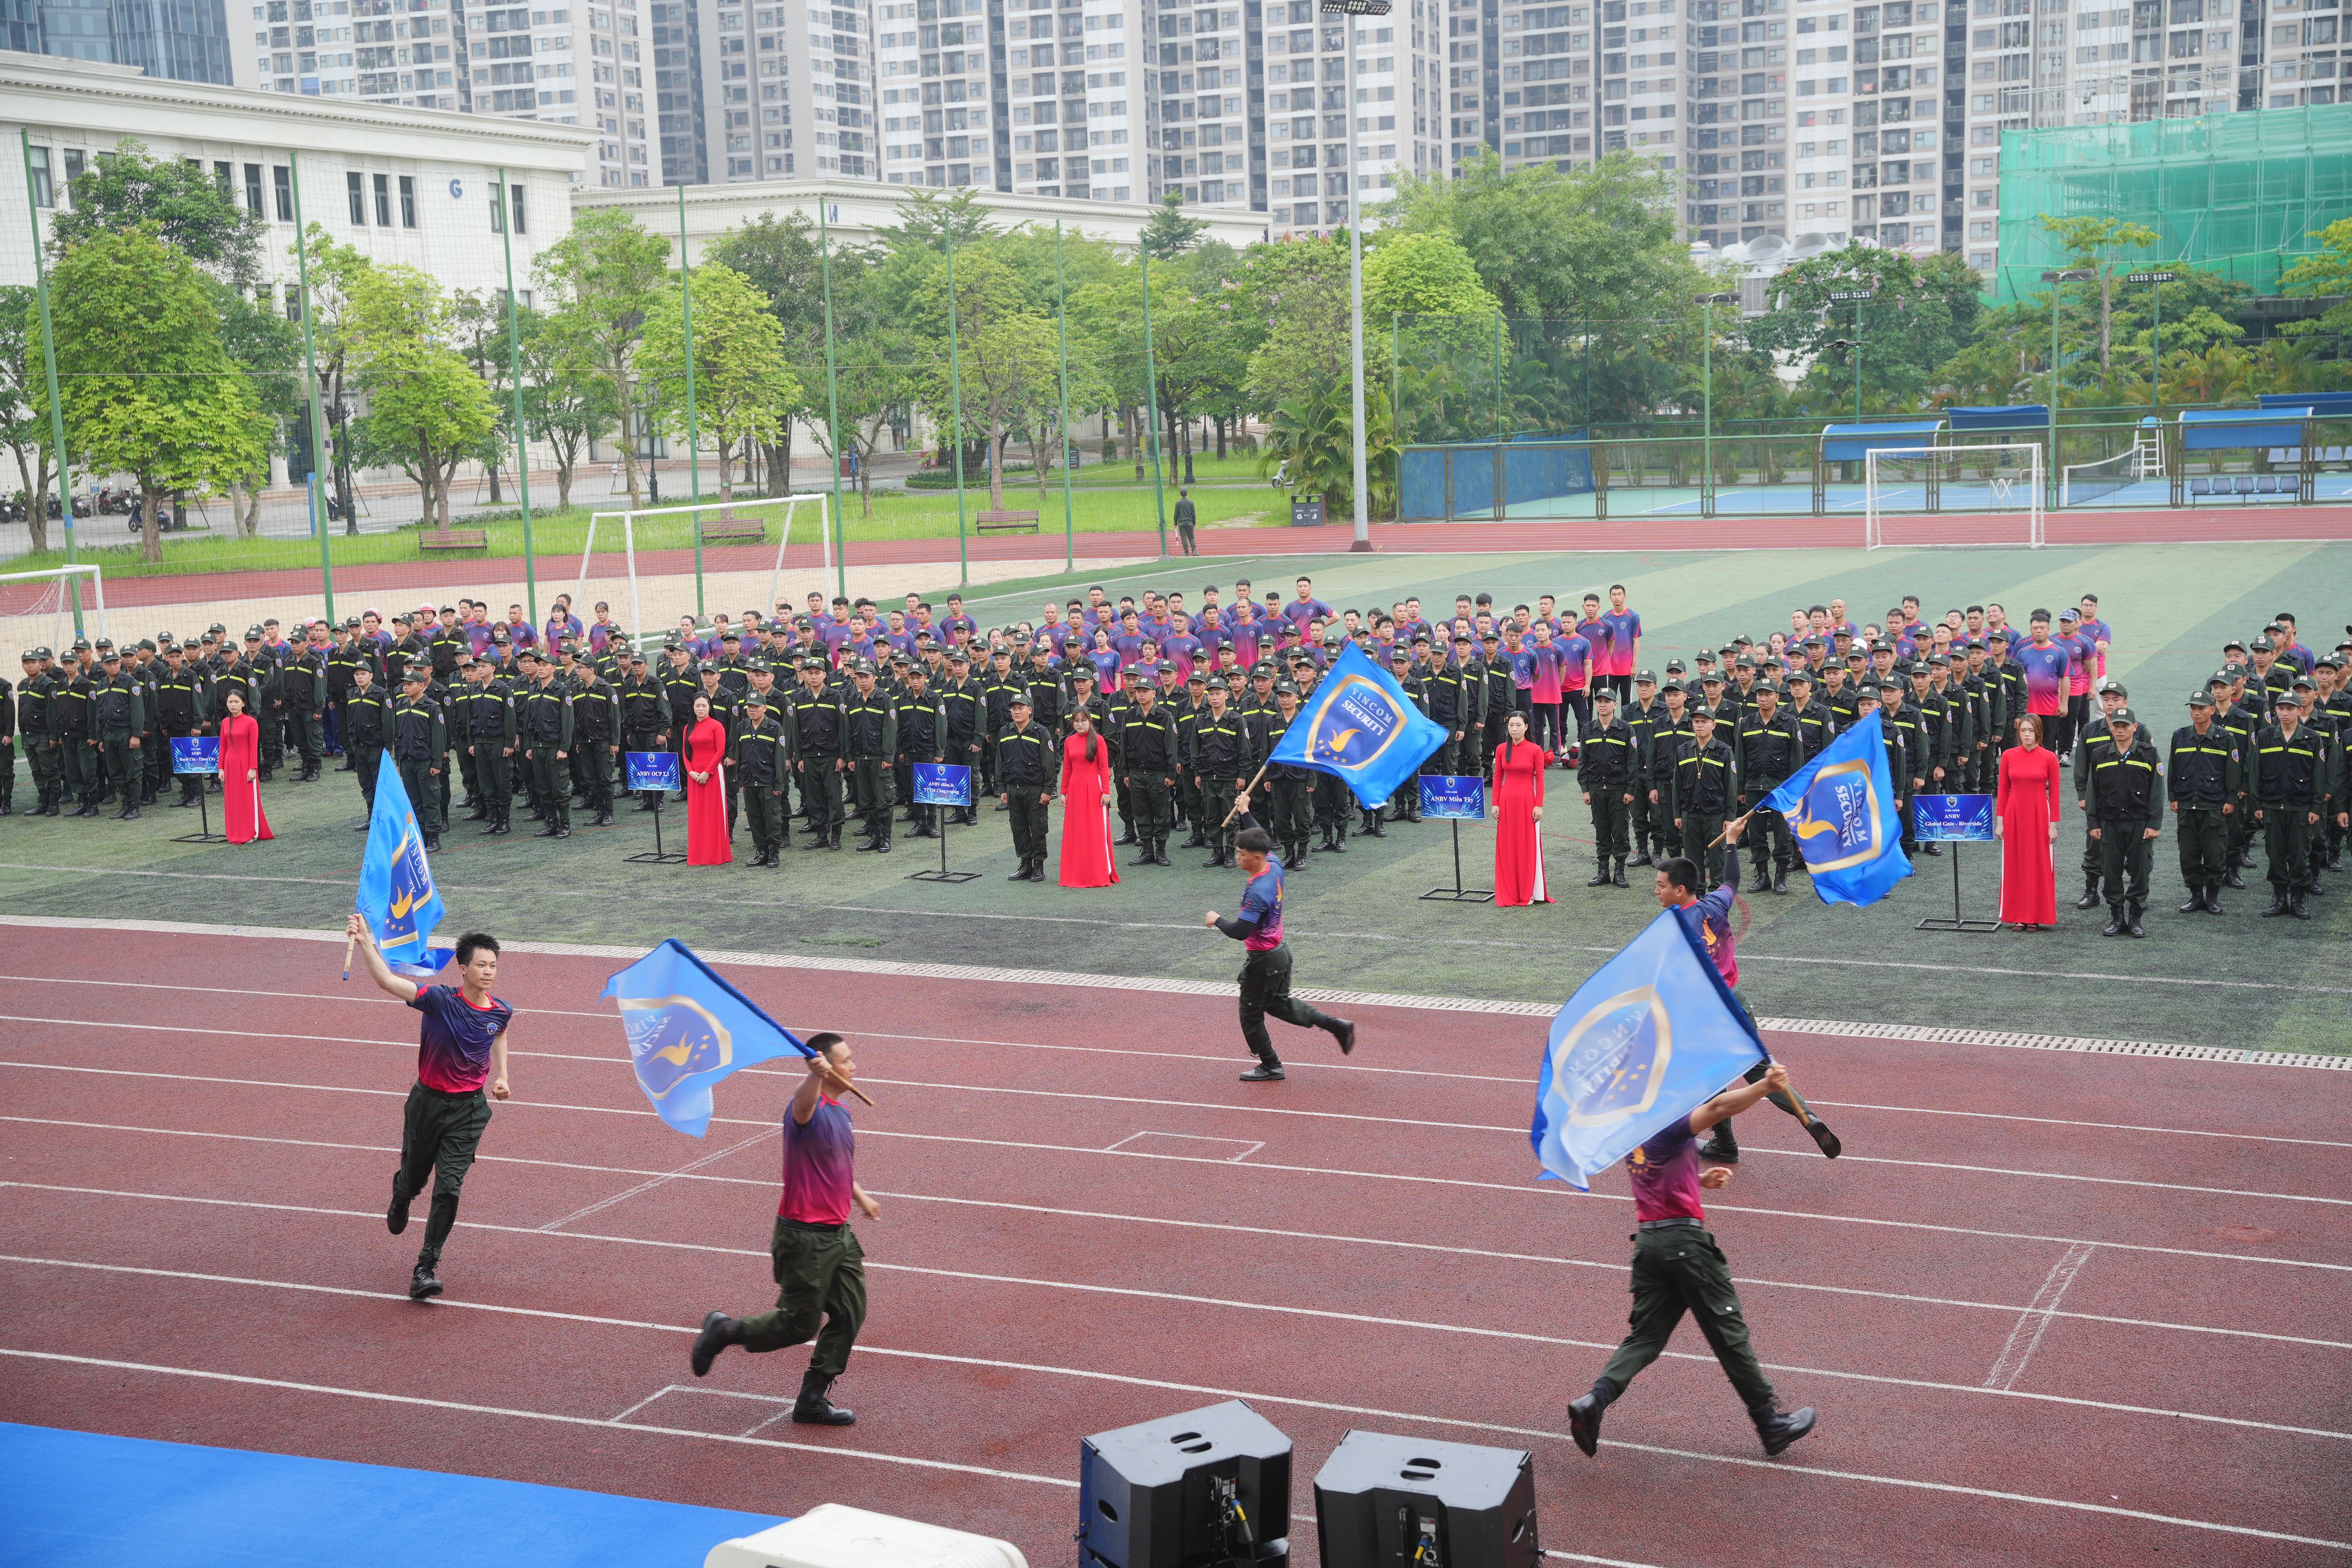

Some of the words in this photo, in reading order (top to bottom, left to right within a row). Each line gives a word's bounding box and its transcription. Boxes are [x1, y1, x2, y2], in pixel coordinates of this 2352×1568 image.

[450, 179, 462, 198] G
[1341, 700, 1386, 737] SECURITY
[1352, 687, 1393, 724] VINCOM
[408, 830, 428, 886] VINCOM
